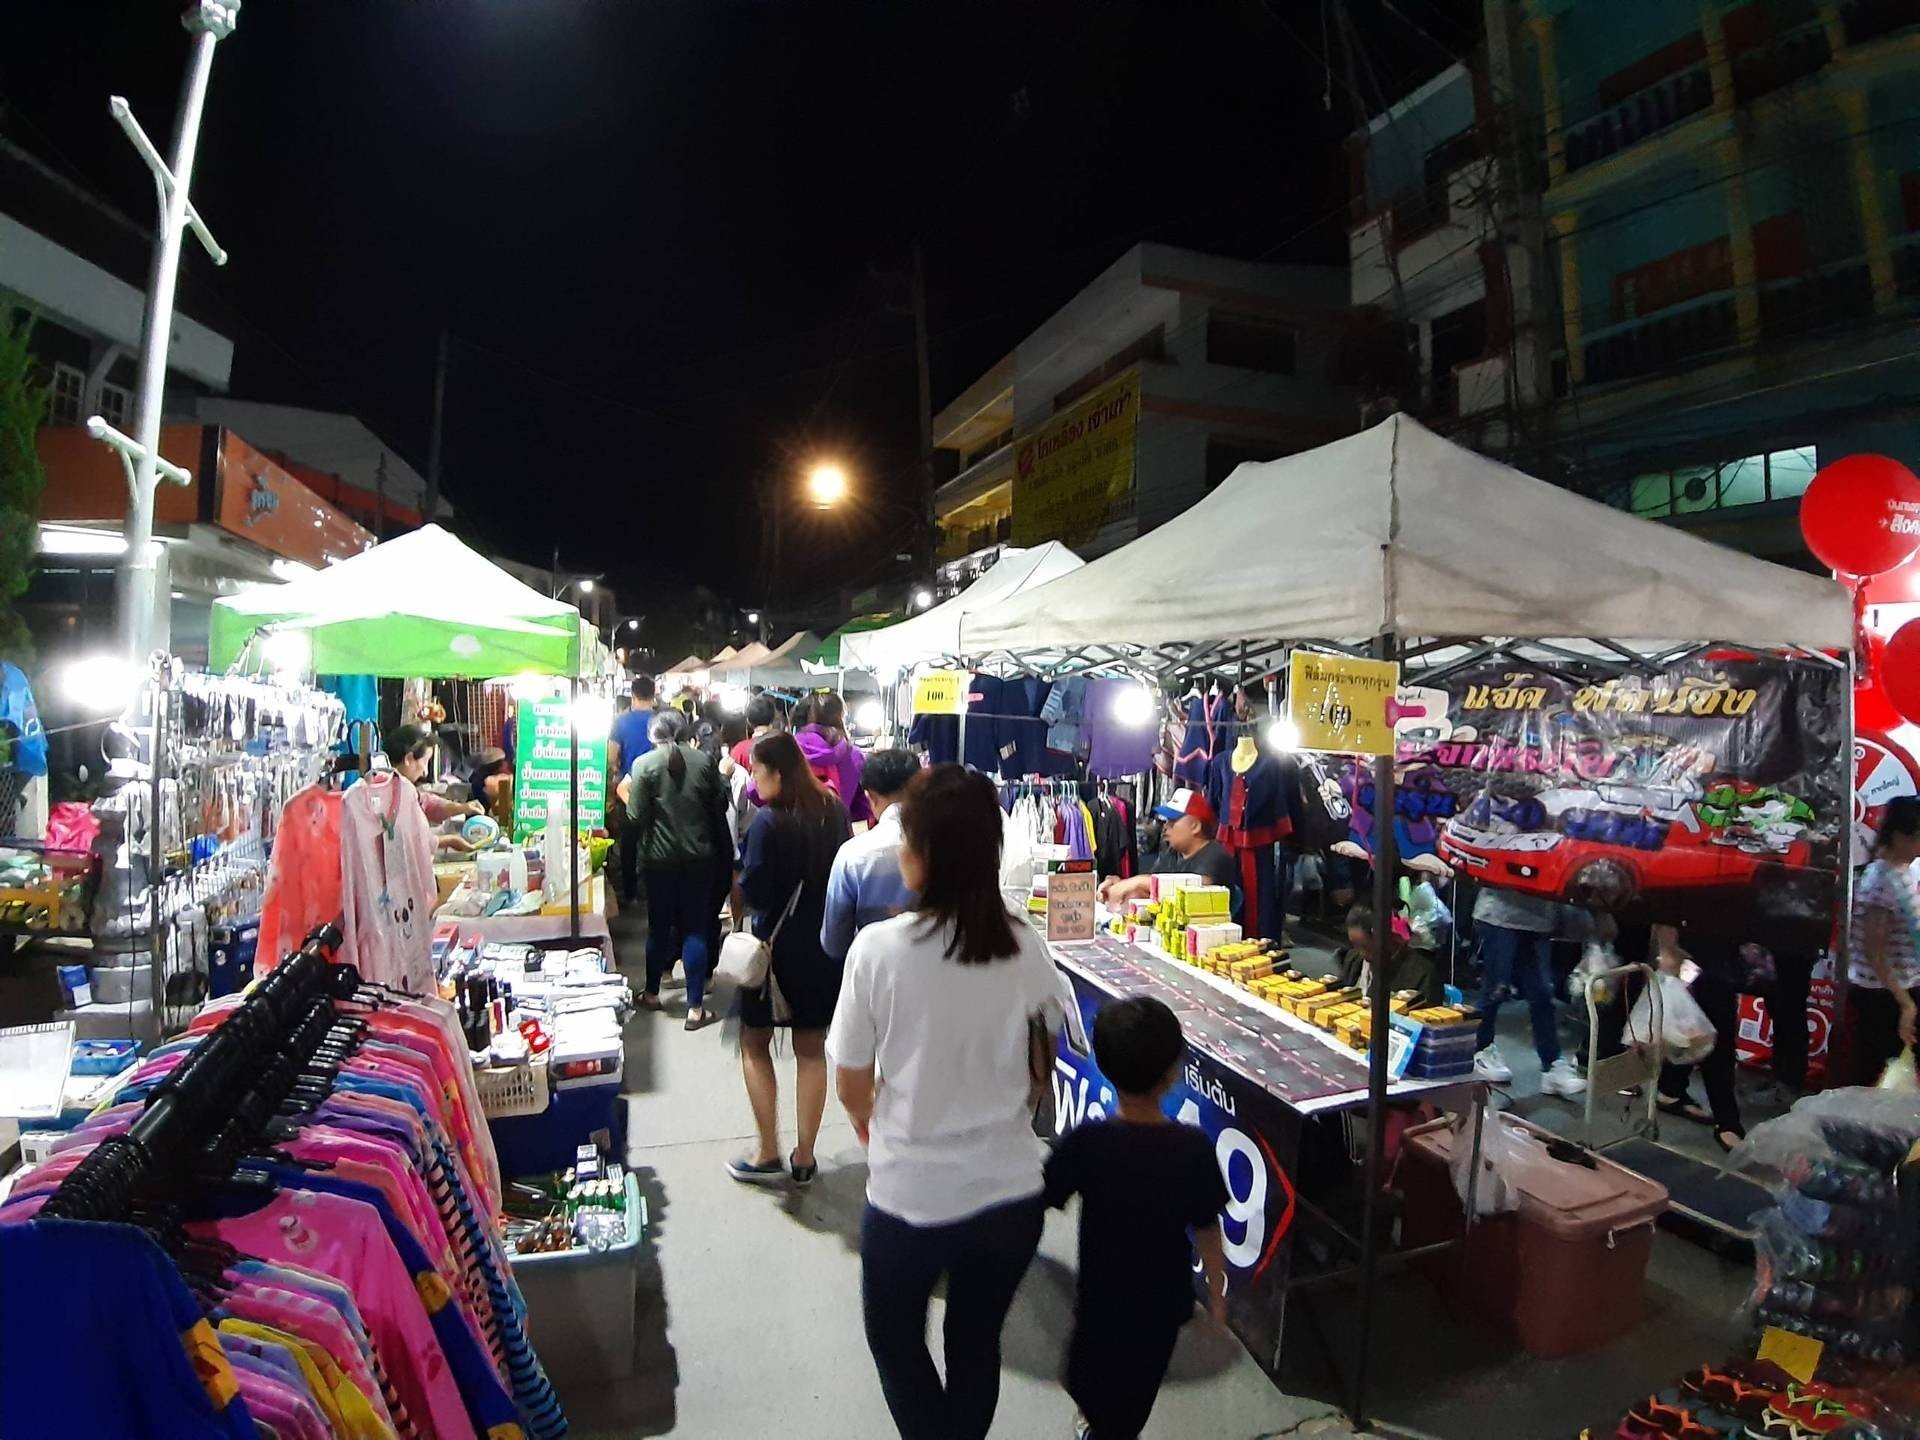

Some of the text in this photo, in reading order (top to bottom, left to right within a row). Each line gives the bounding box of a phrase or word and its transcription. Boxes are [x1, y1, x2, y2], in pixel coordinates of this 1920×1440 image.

[926, 690, 944, 701] 100
[1184, 1057, 1236, 1118] เริ่มต้น
